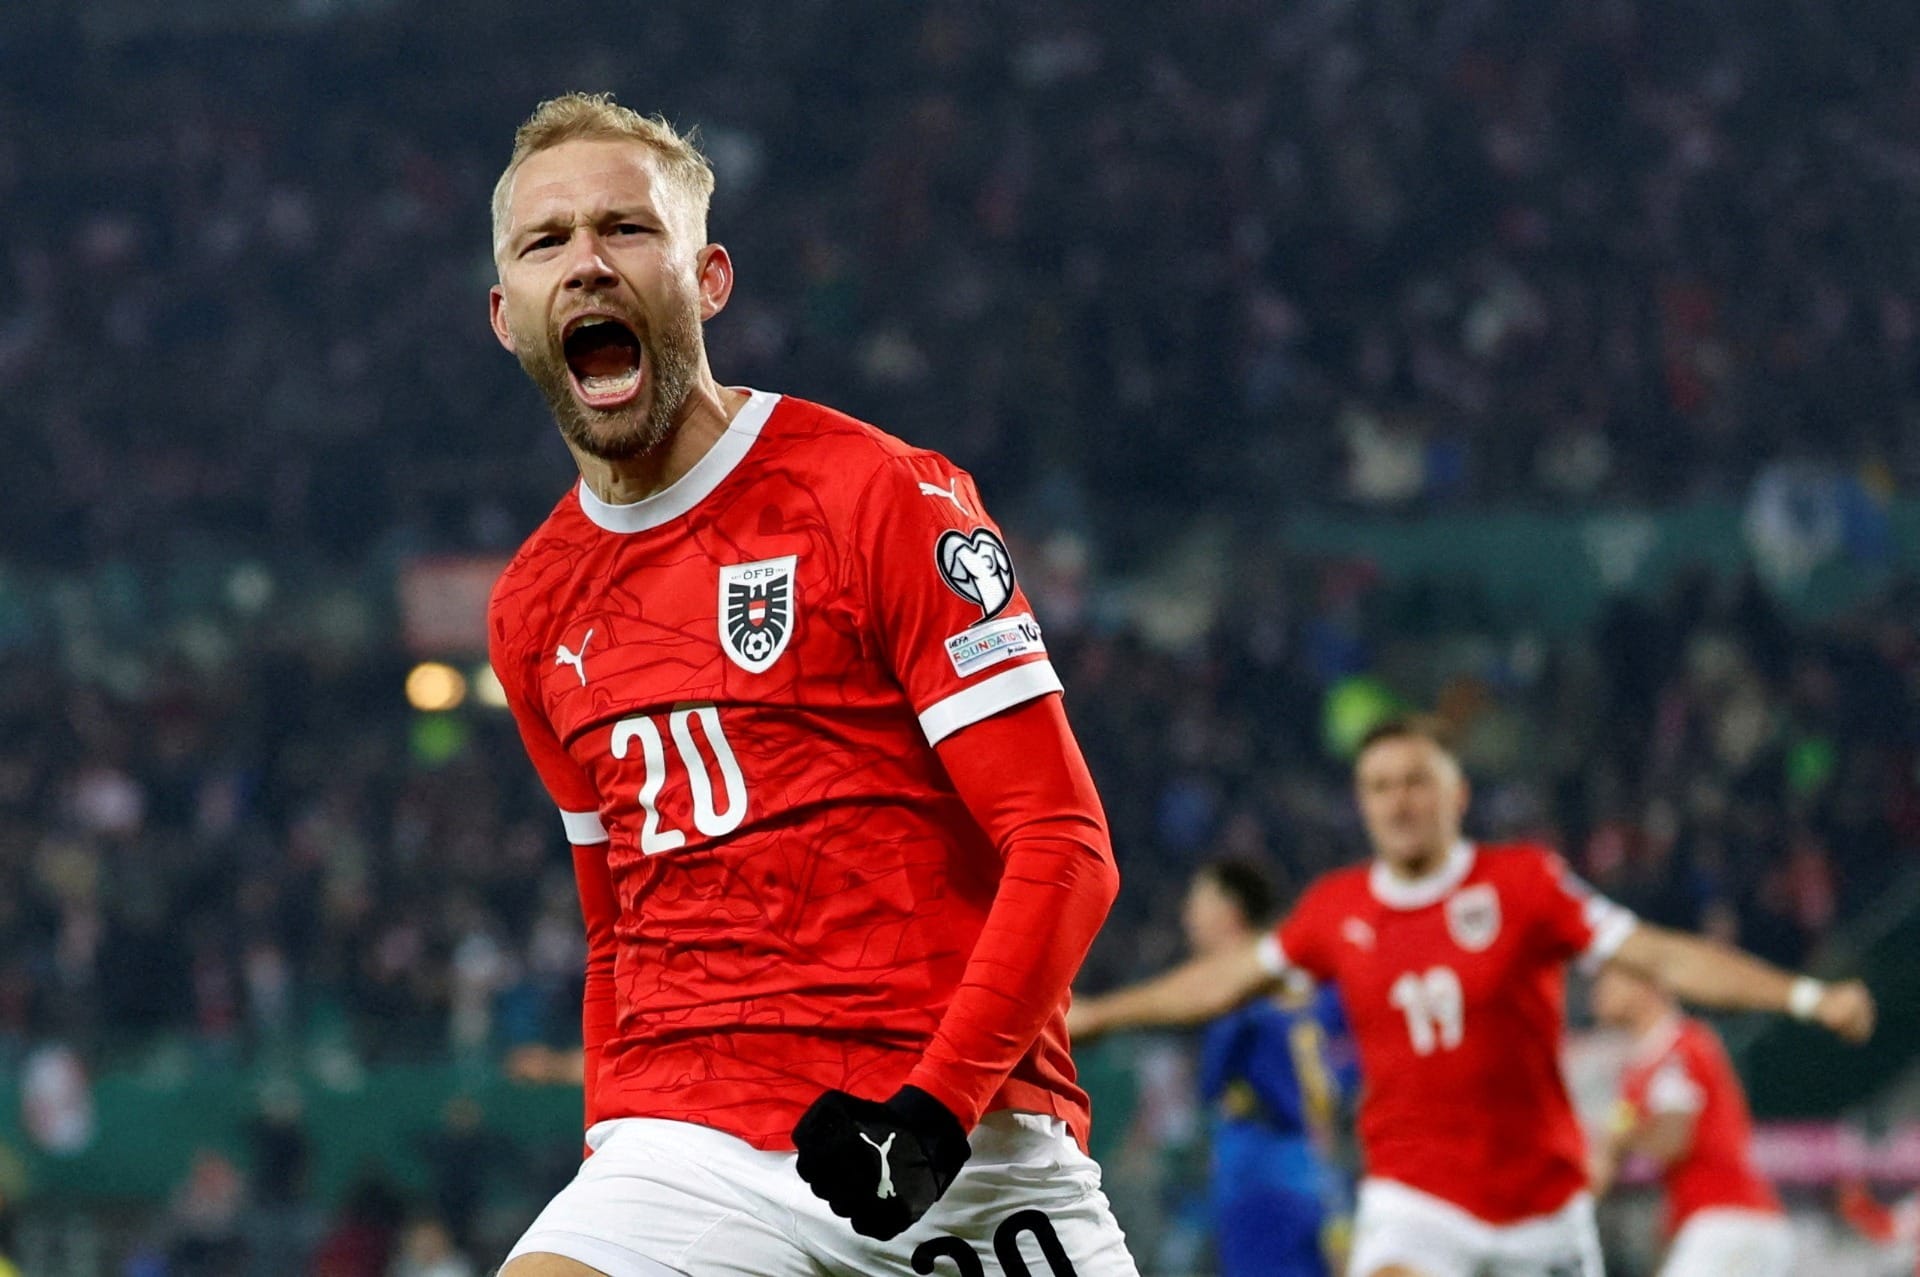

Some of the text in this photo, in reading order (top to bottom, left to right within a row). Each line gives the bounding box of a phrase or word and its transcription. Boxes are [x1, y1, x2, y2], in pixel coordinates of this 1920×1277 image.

[948, 635, 969, 649] UEFA
[611, 701, 748, 856] 20
[1388, 965, 1464, 1056] 19
